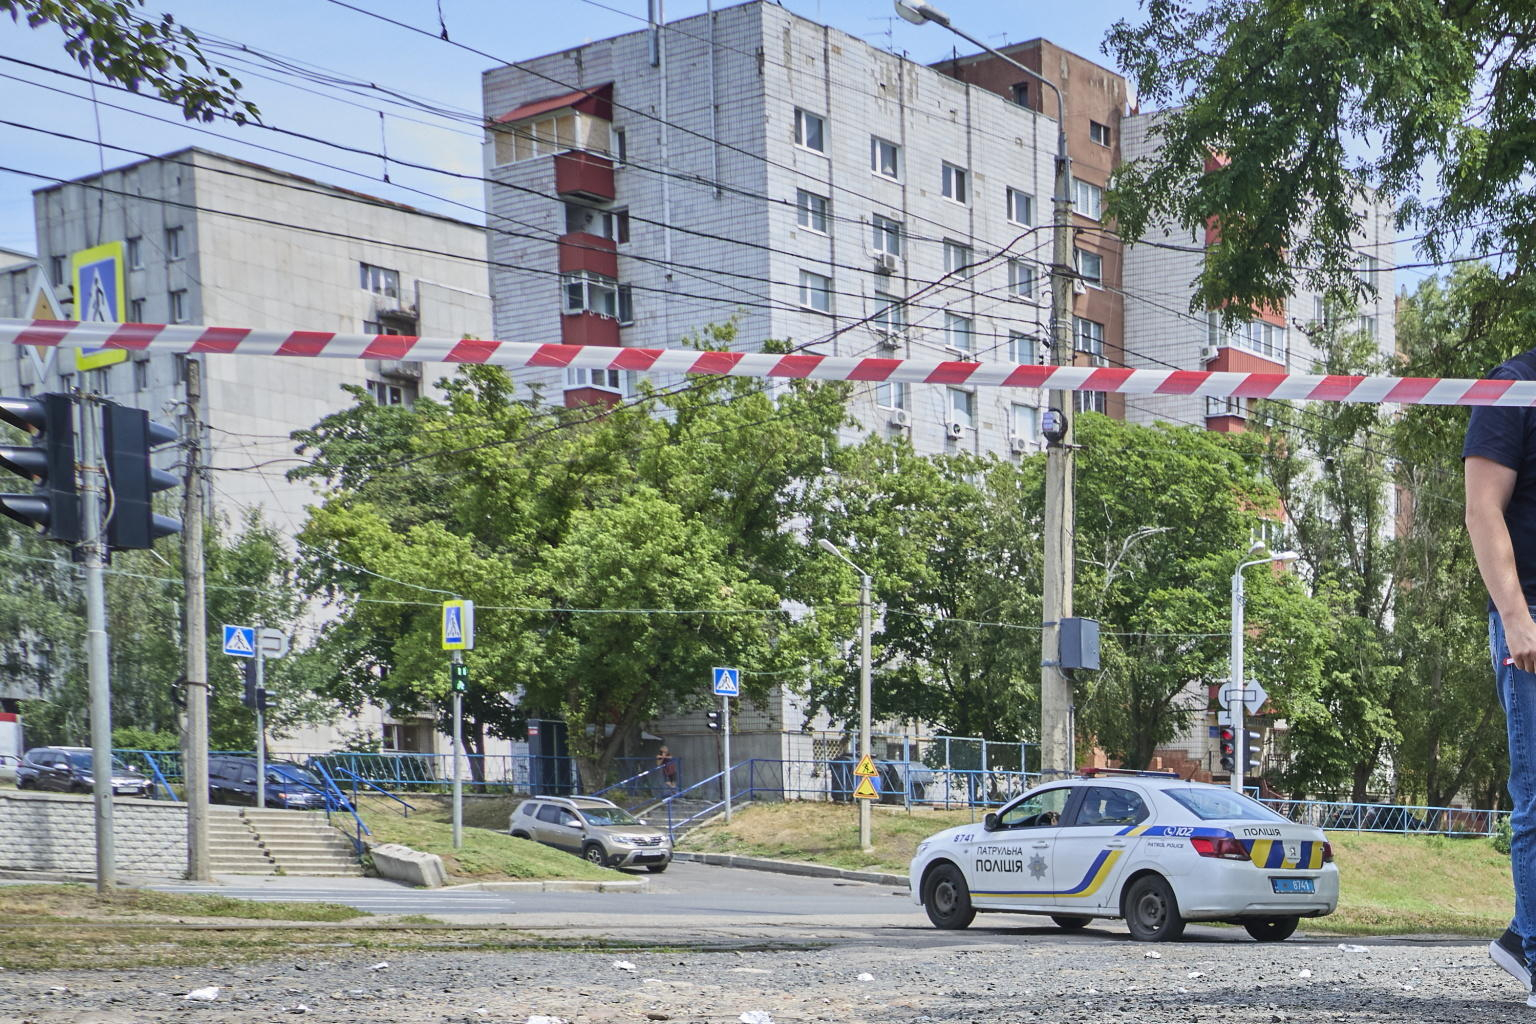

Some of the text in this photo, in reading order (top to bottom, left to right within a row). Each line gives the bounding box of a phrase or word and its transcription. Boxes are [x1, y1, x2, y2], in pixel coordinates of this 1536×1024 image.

[1175, 827, 1194, 836] 102
[1243, 828, 1281, 836] ПОЛІЦІЯ
[953, 834, 975, 842] 8741
[976, 846, 1023, 855] ПАТРУЛЬНА
[975, 859, 1023, 872] ПОЛІЦІЯ
[1292, 880, 1310, 890] 8741
